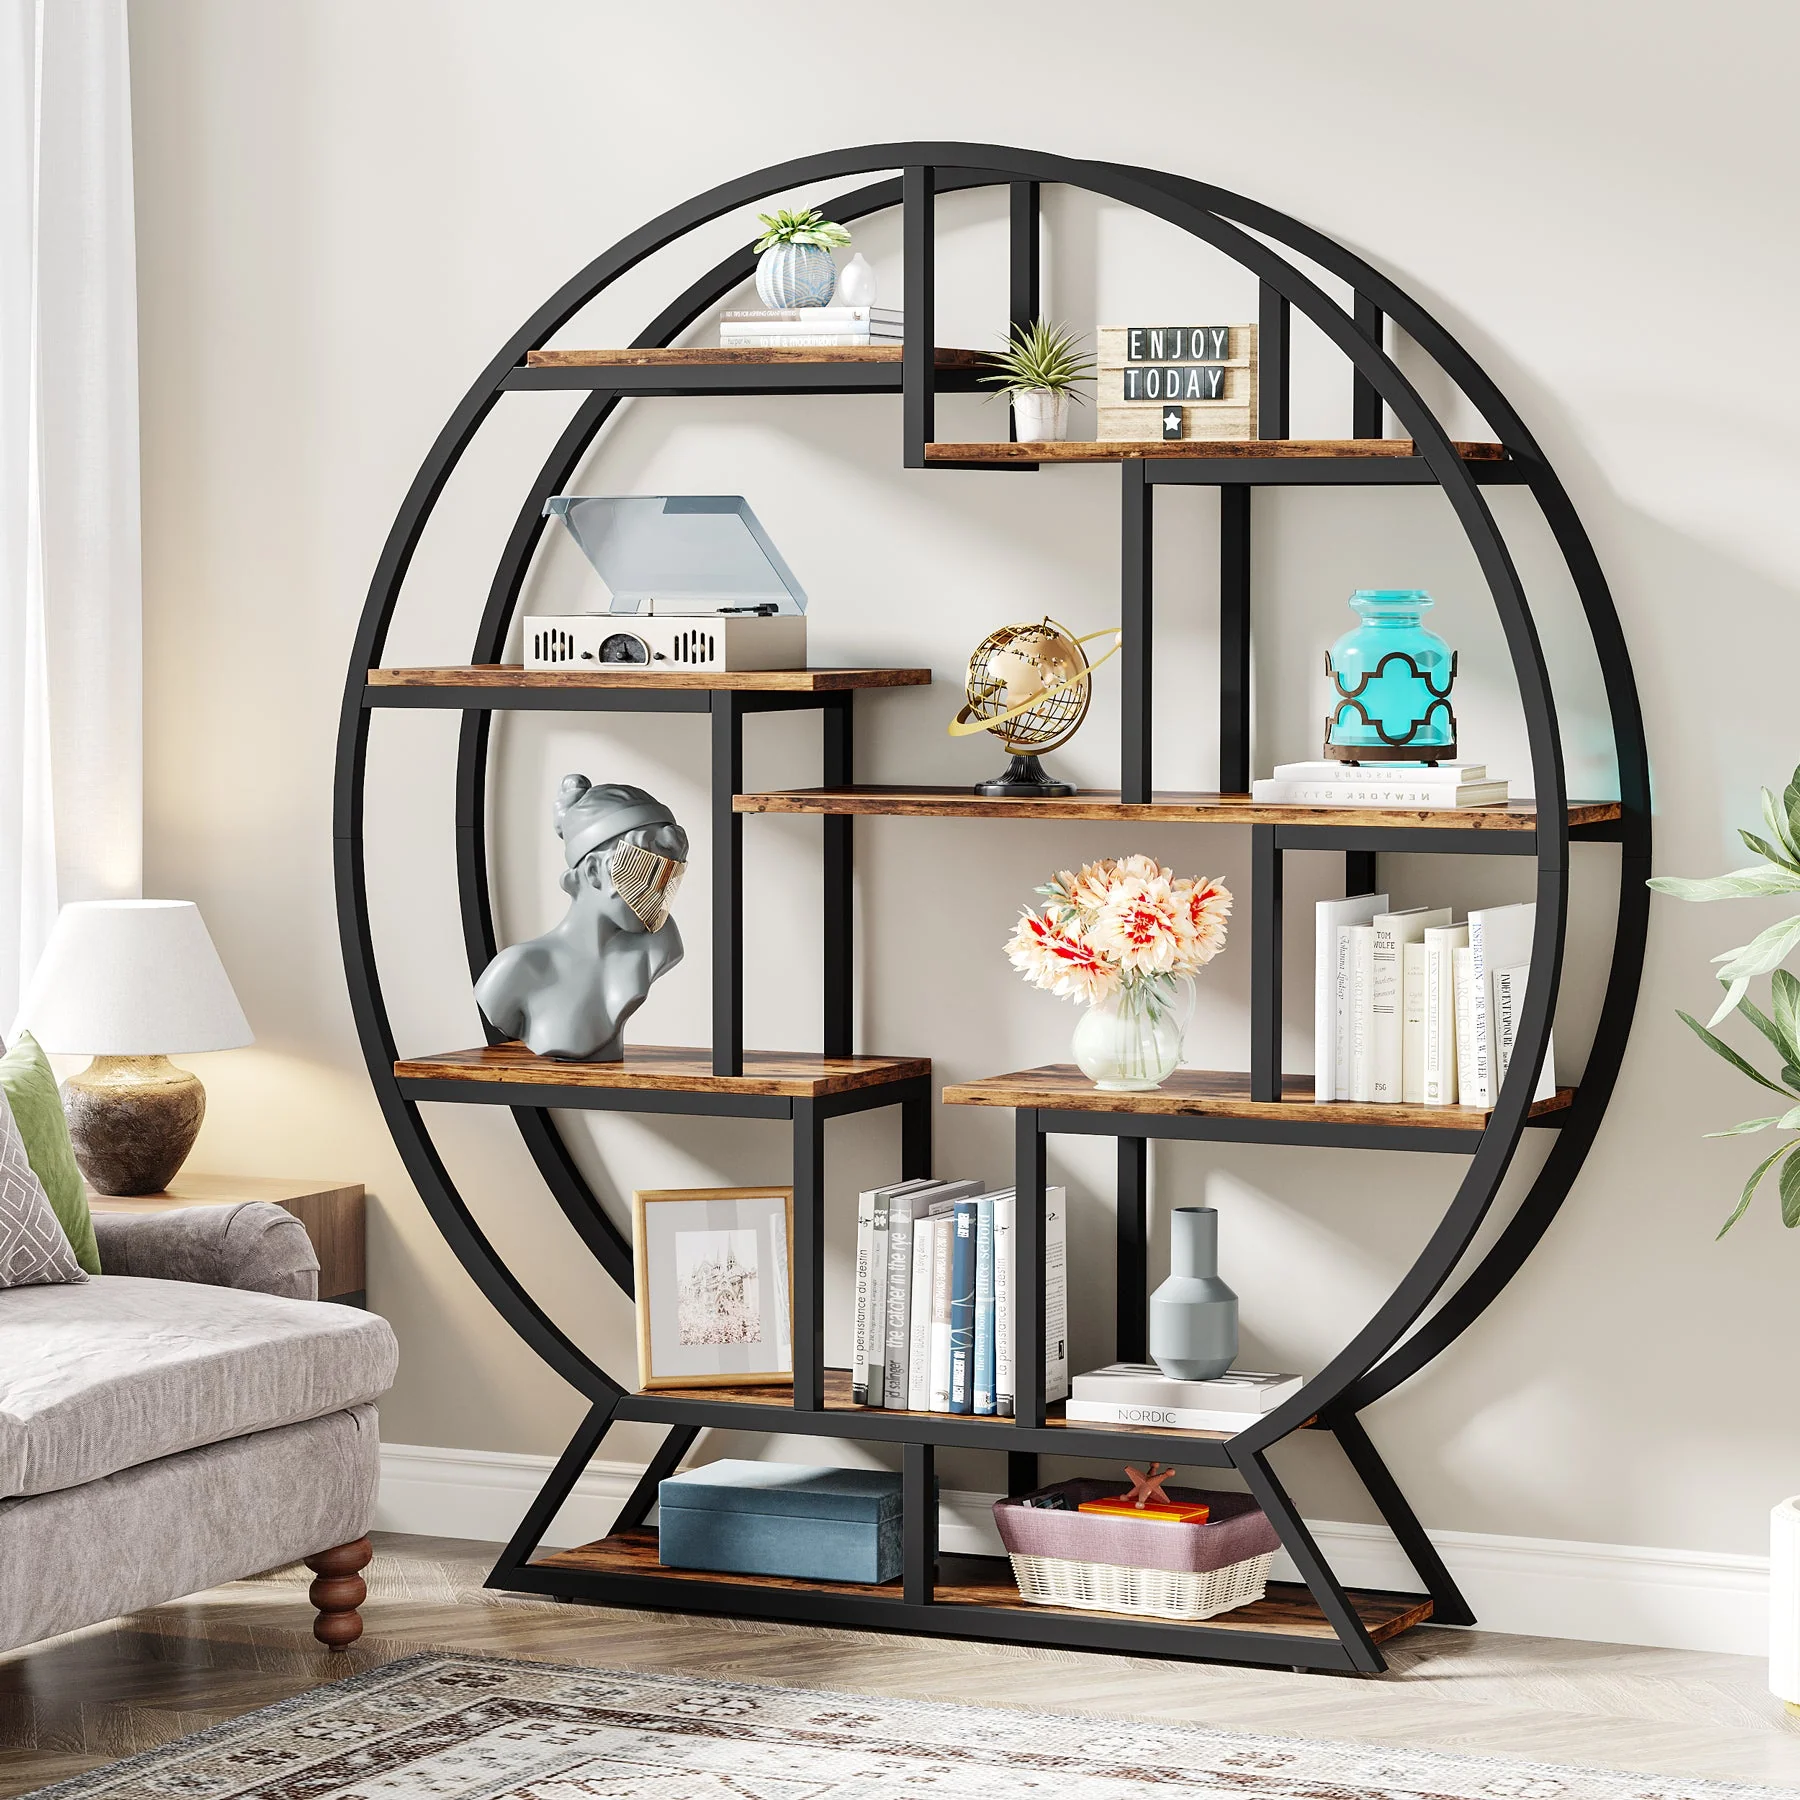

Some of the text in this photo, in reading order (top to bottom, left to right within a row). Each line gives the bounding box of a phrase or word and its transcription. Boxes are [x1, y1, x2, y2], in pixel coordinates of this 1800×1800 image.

[1131, 328, 1225, 359] ENJOY
[1126, 369, 1222, 398] TODAY
[1373, 941, 1396, 950] WOLFE
[1376, 931, 1391, 940] TOM
[1472, 923, 1484, 981] INSPIRATION
[1430, 978, 1438, 1002] AND
[1456, 975, 1470, 1029] ARCTIC
[1430, 1004, 1438, 1027] THE
[1500, 974, 1513, 1047] INDECENT EXPOSURE
[1476, 1012, 1486, 1043] WAYNE
[1430, 1030, 1438, 1072] FUTURE
[1459, 1033, 1472, 1092] DREAMS
[1477, 1056, 1488, 1079] DYER
[1375, 1082, 1387, 1091] FSG
[977, 1214, 991, 1294] alice sebold
[888, 1232, 912, 1348] the catcher in the rye
[855, 1249, 869, 1366] La persistance du destin
[996, 1258, 1012, 1376] La persistance du destin
[976, 1333, 989, 1356] lovely
[976, 1356, 985, 1371] the
[886, 1359, 903, 1400] jd salinger
[1118, 1409, 1177, 1424] NORDIC
